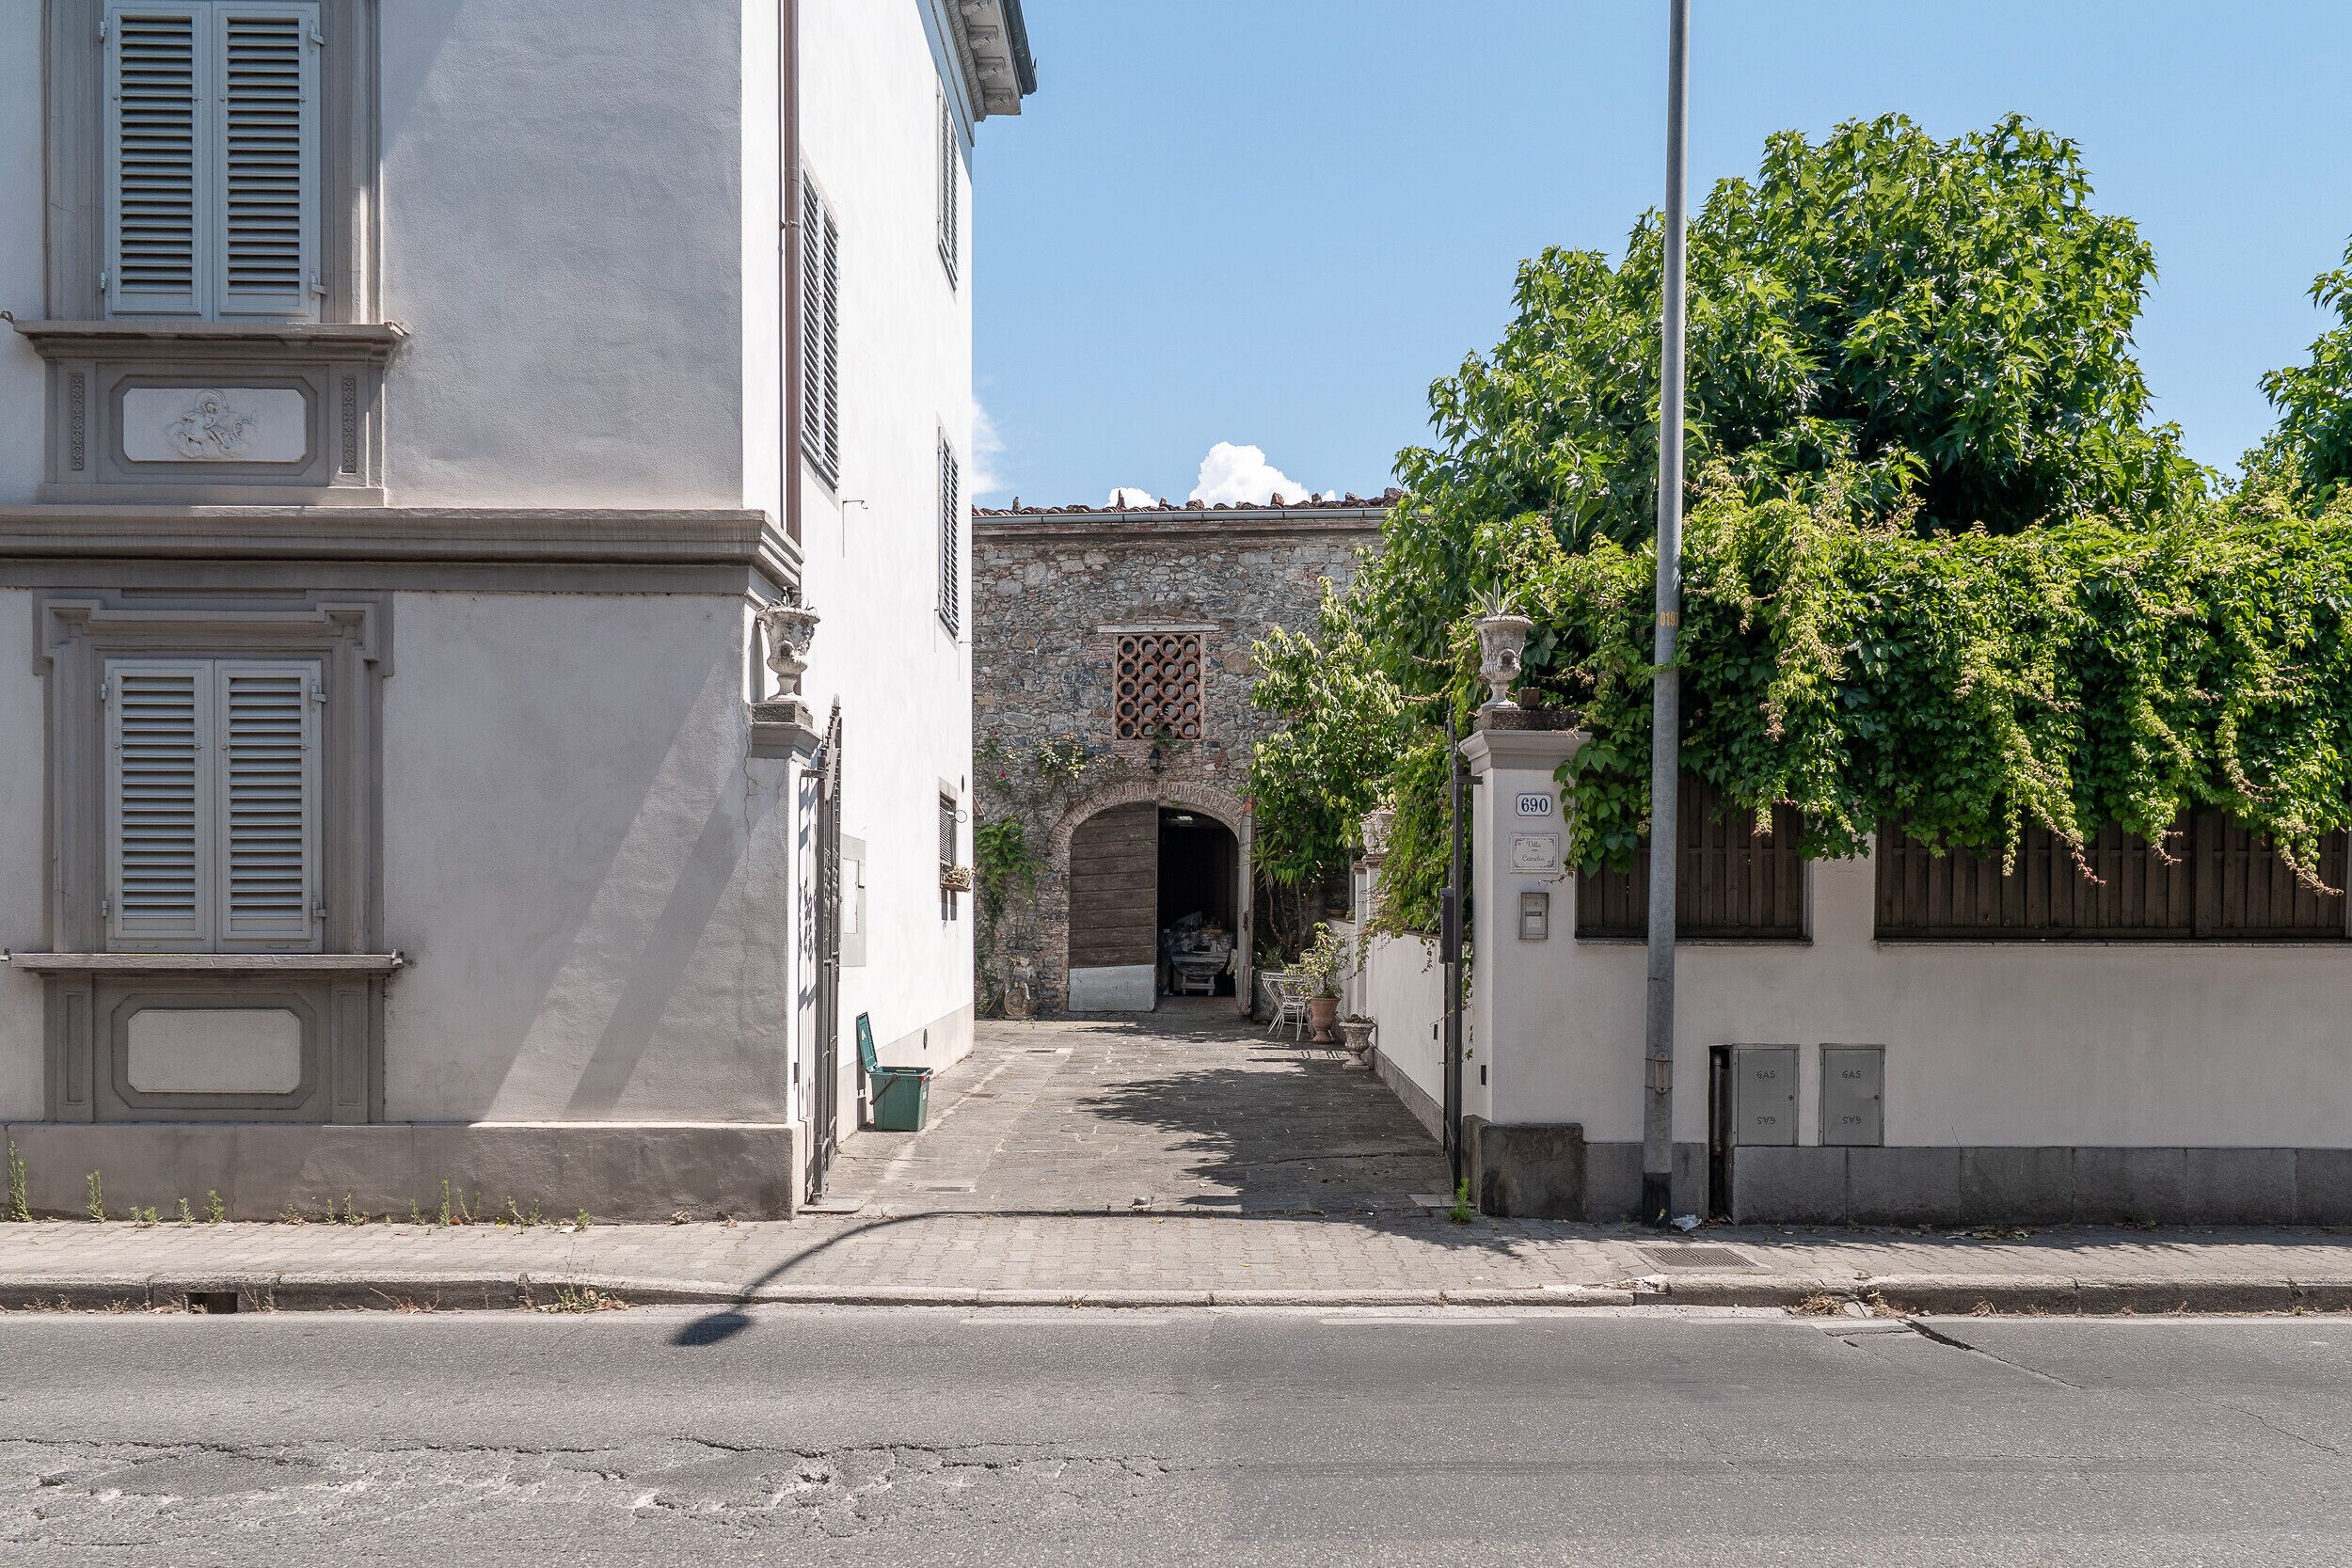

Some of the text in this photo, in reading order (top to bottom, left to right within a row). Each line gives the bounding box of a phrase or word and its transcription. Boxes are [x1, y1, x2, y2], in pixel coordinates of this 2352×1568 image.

[1521, 798, 1548, 812] 690
[1756, 1070, 1775, 1079] GAS
[1841, 1070, 1861, 1079] GAS
